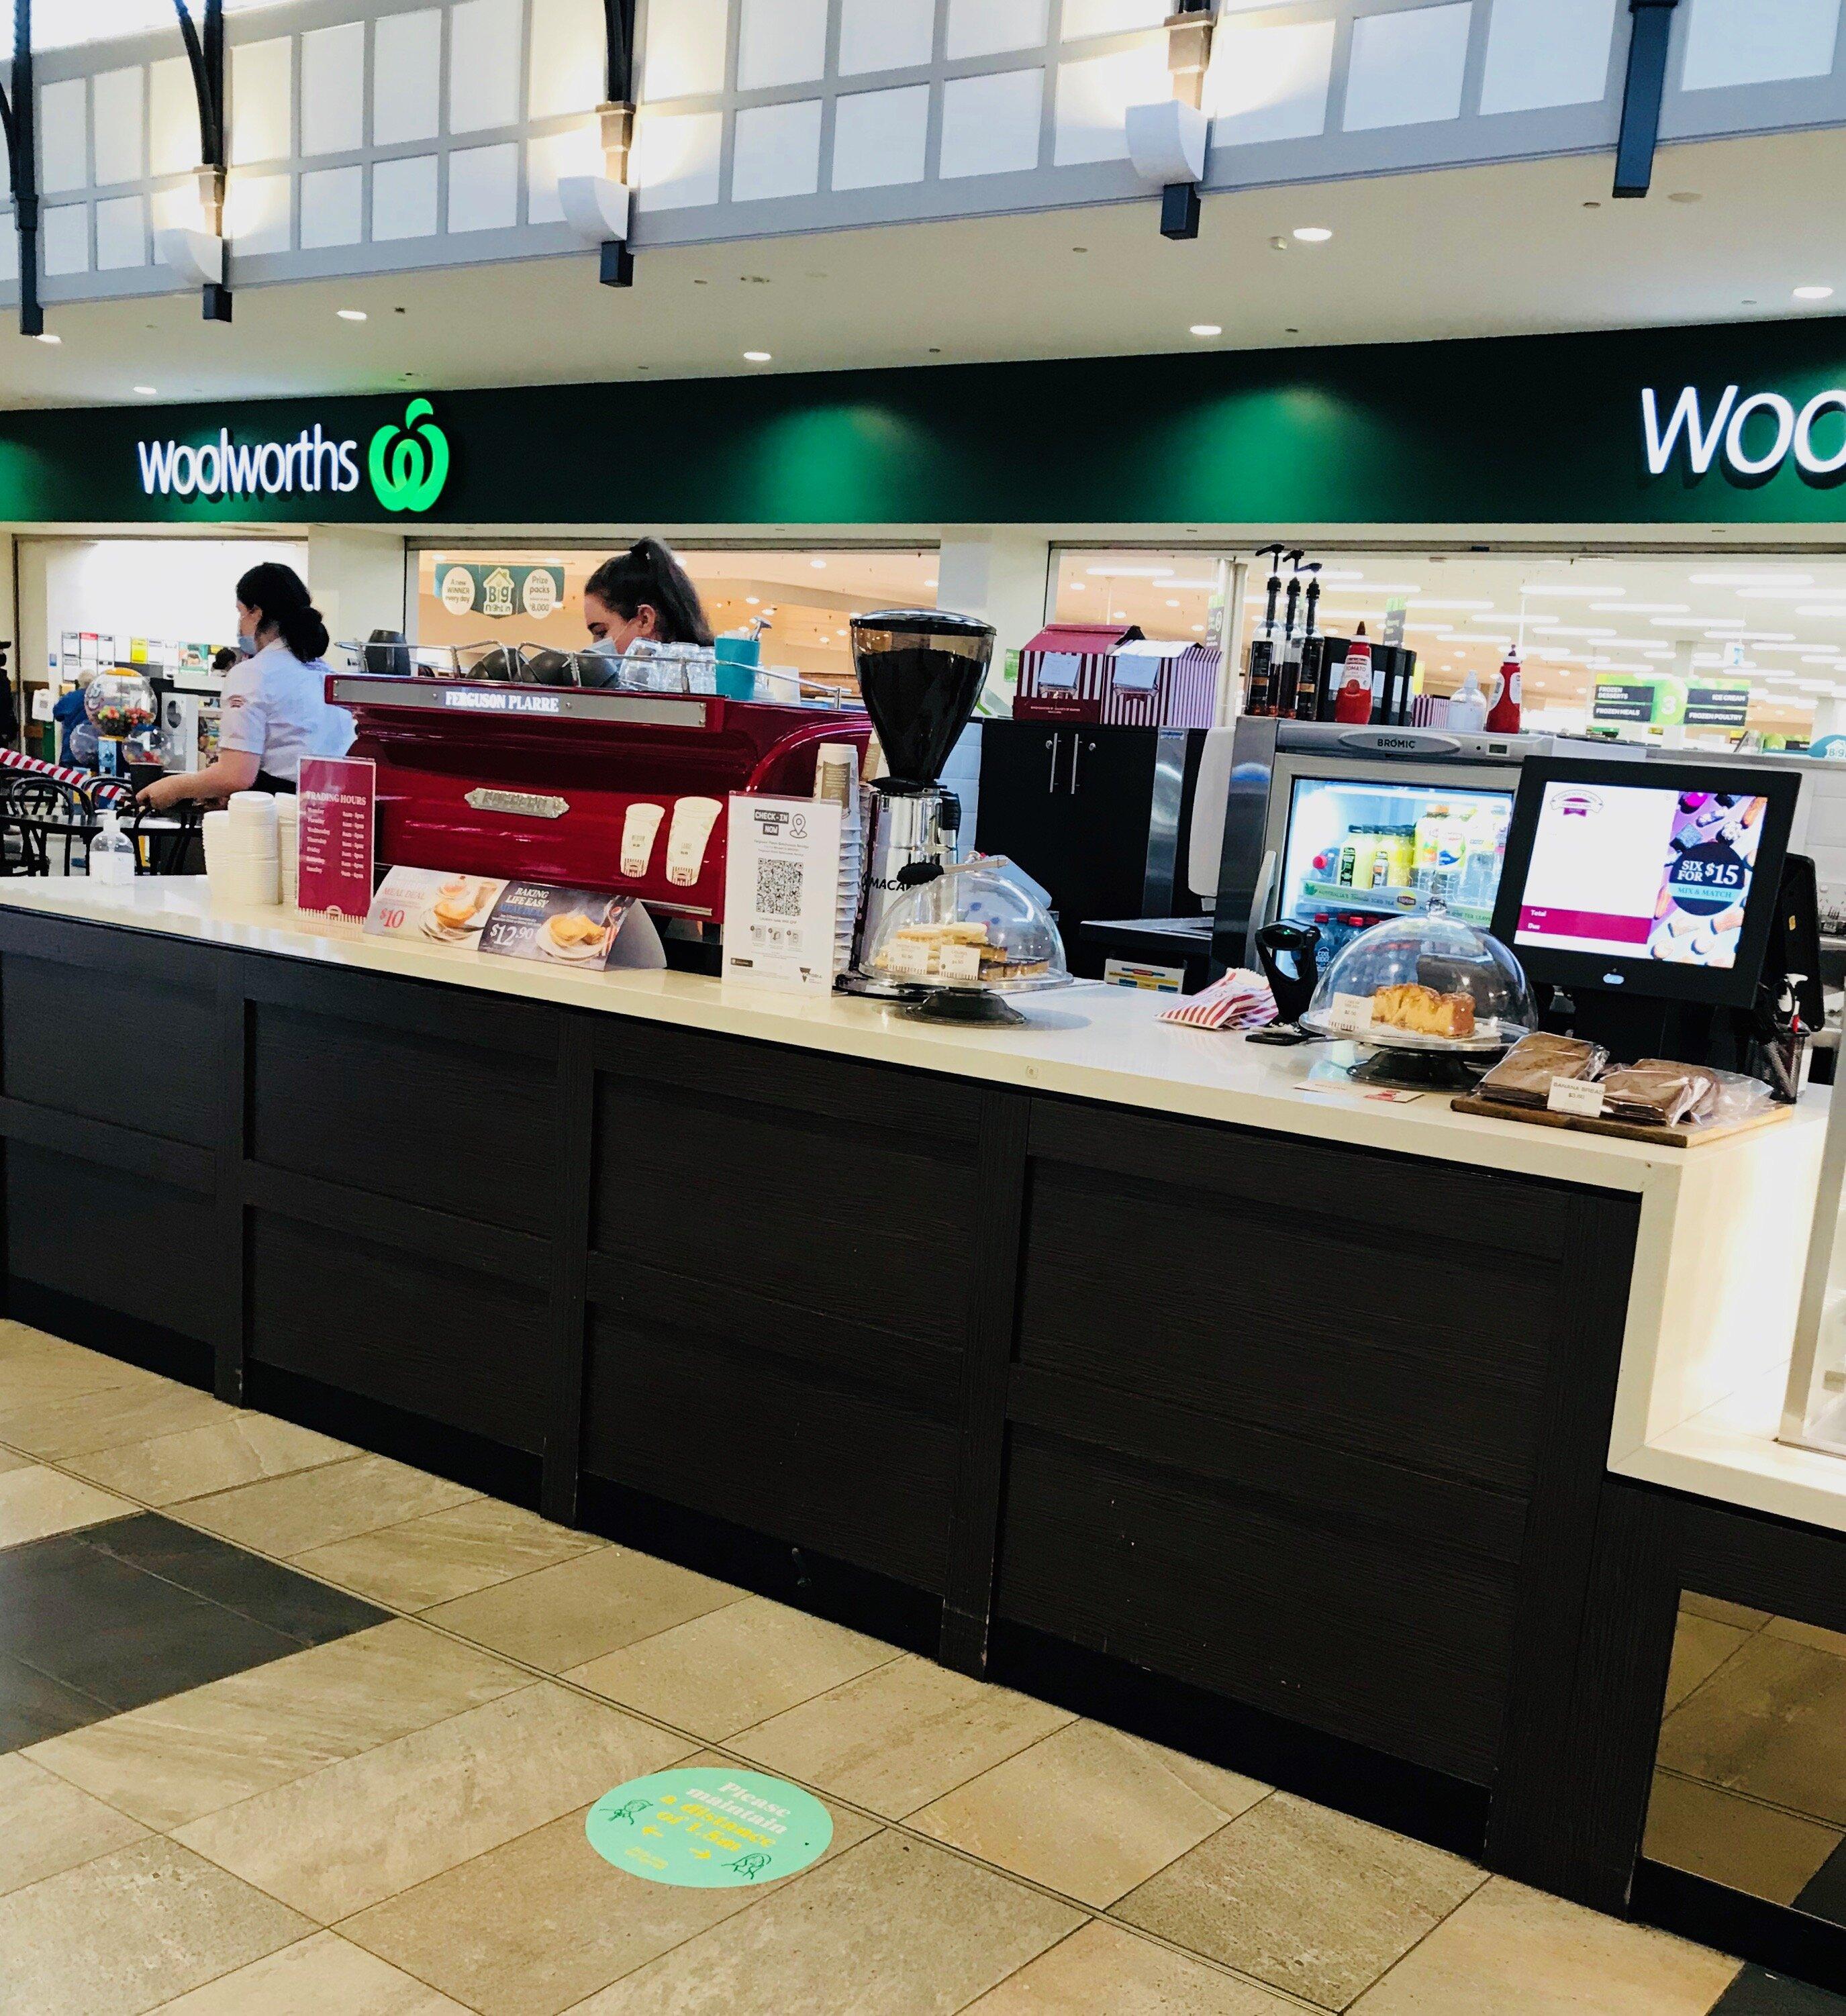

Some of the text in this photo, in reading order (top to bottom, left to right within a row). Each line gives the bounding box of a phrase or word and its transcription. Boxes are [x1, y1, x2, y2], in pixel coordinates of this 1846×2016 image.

[138, 428, 359, 495] Woolworths
[532, 575, 548, 584] Prize
[446, 691, 559, 713] FERGUSON PLARRE
[1661, 695, 1677, 715] 3
[1688, 711, 1743, 721] FROZEN POULTRY
[1377, 738, 1416, 749] BROMIC
[305, 791, 367, 806] TRADING HOURS
[755, 811, 789, 823] CHECK-IN
[764, 825, 779, 834] NOW
[1682, 860, 1704, 872] SIX
[1677, 869, 1704, 882] FOR
[1705, 862, 1740, 885] $15
[870, 877, 912, 892] MACA
[383, 887, 425, 901] MEAL DEAL
[514, 887, 550, 899] BAKING
[1702, 889, 1733, 898] MATCH
[505, 894, 550, 909] LIFE EASY
[379, 907, 405, 929] $10
[1530, 909, 1547, 917] Total
[489, 923, 535, 946] $12.90
[1553, 1082, 1580, 1091] BANANA
[717, 1781, 791, 1817] Please
[685, 1788, 787, 1834] maintain
